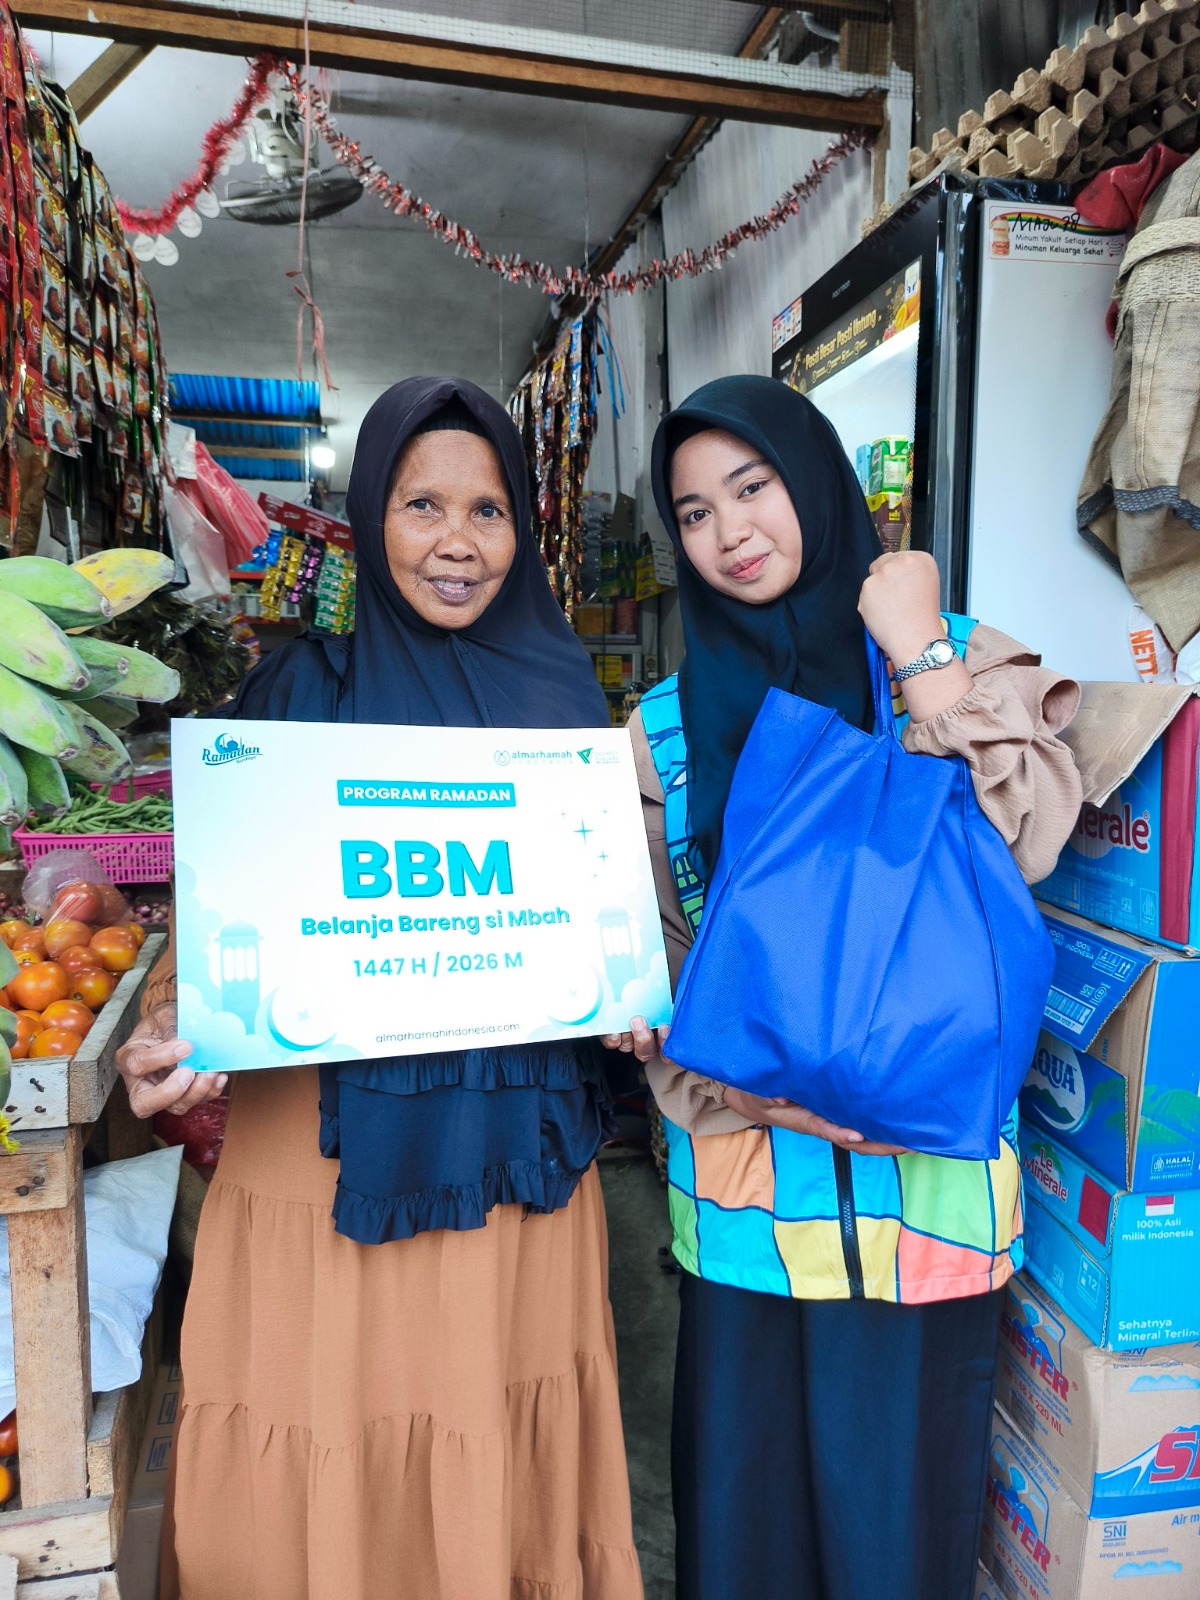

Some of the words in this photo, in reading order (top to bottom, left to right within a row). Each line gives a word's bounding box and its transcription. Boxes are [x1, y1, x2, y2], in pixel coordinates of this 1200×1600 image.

[1016, 234, 1039, 242] Minum
[1065, 237, 1086, 246] Setiap
[1015, 244, 1047, 252] Minuman
[1050, 245, 1081, 256] Keluarga
[1084, 248, 1104, 256] Sehat
[837, 322, 853, 348] Pasti
[853, 309, 877, 337] Untung
[202, 744, 260, 762] Ramadan
[511, 750, 573, 759] almarhamah
[343, 787, 427, 801] PROGRAM
[430, 788, 511, 802] RAMADAN
[1078, 803, 1149, 851] erale
[340, 840, 513, 899] BBM
[1098, 868, 1136, 887] Terlindungi
[301, 913, 393, 939] Belanja
[398, 913, 480, 936] Bareng
[485, 910, 503, 929] si
[508, 907, 570, 928] Mbah
[1065, 943, 1094, 960] INDONESIA
[1075, 940, 1092, 952] 100%
[353, 957, 405, 977] 1447
[411, 957, 426, 974] H
[432, 951, 441, 978] /
[447, 953, 499, 973] 2026
[504, 952, 523, 968] M
[375, 1022, 521, 1043] almarhamahindonesia.com
[1040, 1147, 1053, 1172] Le
[1166, 1156, 1191, 1165] HALAL
[1023, 1151, 1067, 1202] Minerale
[1136, 1219, 1162, 1229] 100%
[1164, 1217, 1182, 1227] Asli
[1122, 1231, 1146, 1241] milik
[1148, 1228, 1194, 1239] Indonesia
[1088, 1275, 1098, 1292] 12
[1119, 1319, 1172, 1330] Sehatnya
[1118, 1330, 1161, 1342] Mineral
[1035, 1399, 1050, 1421] 220
[1051, 1417, 1064, 1437] ML
[1171, 1513, 1188, 1526] Air
[1103, 1524, 1127, 1538] SNI
